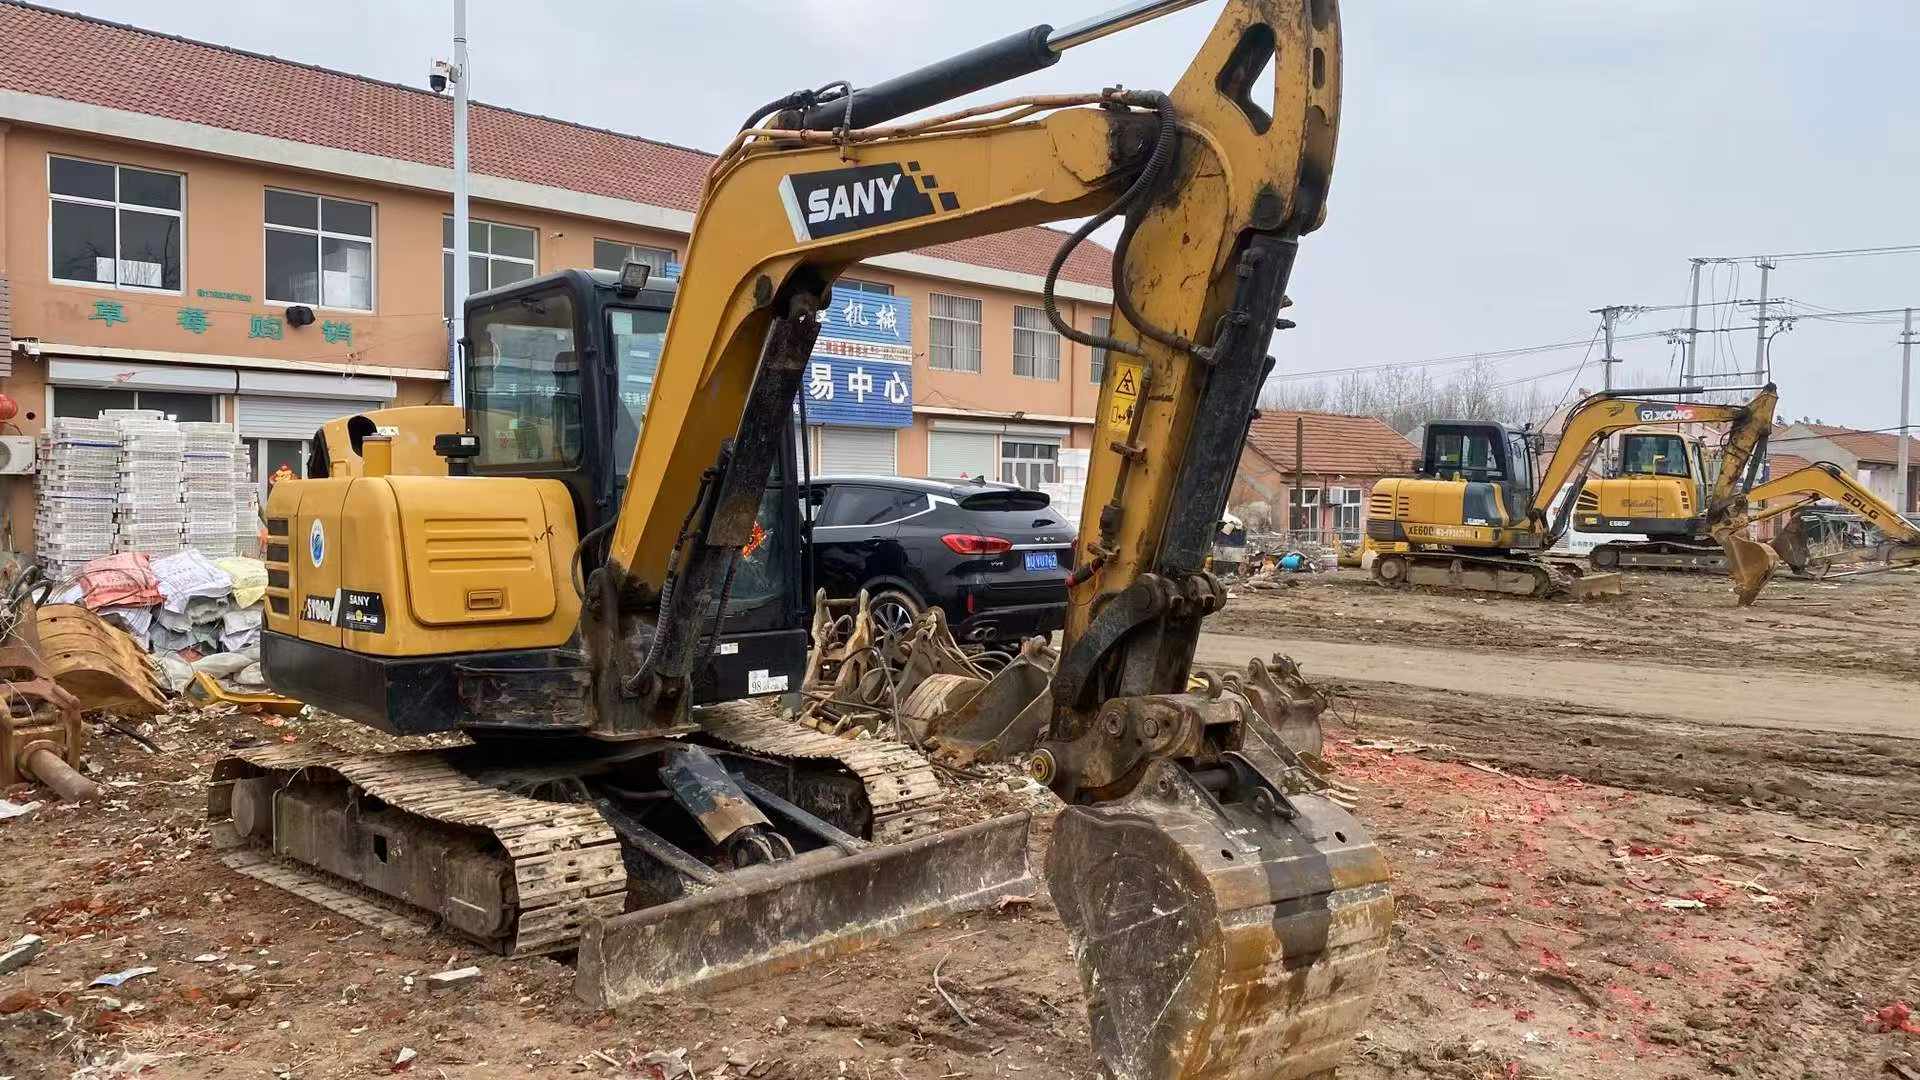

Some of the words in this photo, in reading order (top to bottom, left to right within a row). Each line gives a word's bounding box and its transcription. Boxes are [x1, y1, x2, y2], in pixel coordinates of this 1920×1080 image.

[808, 173, 902, 224] SANY
[808, 362, 909, 404] 易中心
[1654, 410, 1694, 421] XCMG
[1841, 492, 1880, 520] SDLG
[349, 594, 370, 606] SANY
